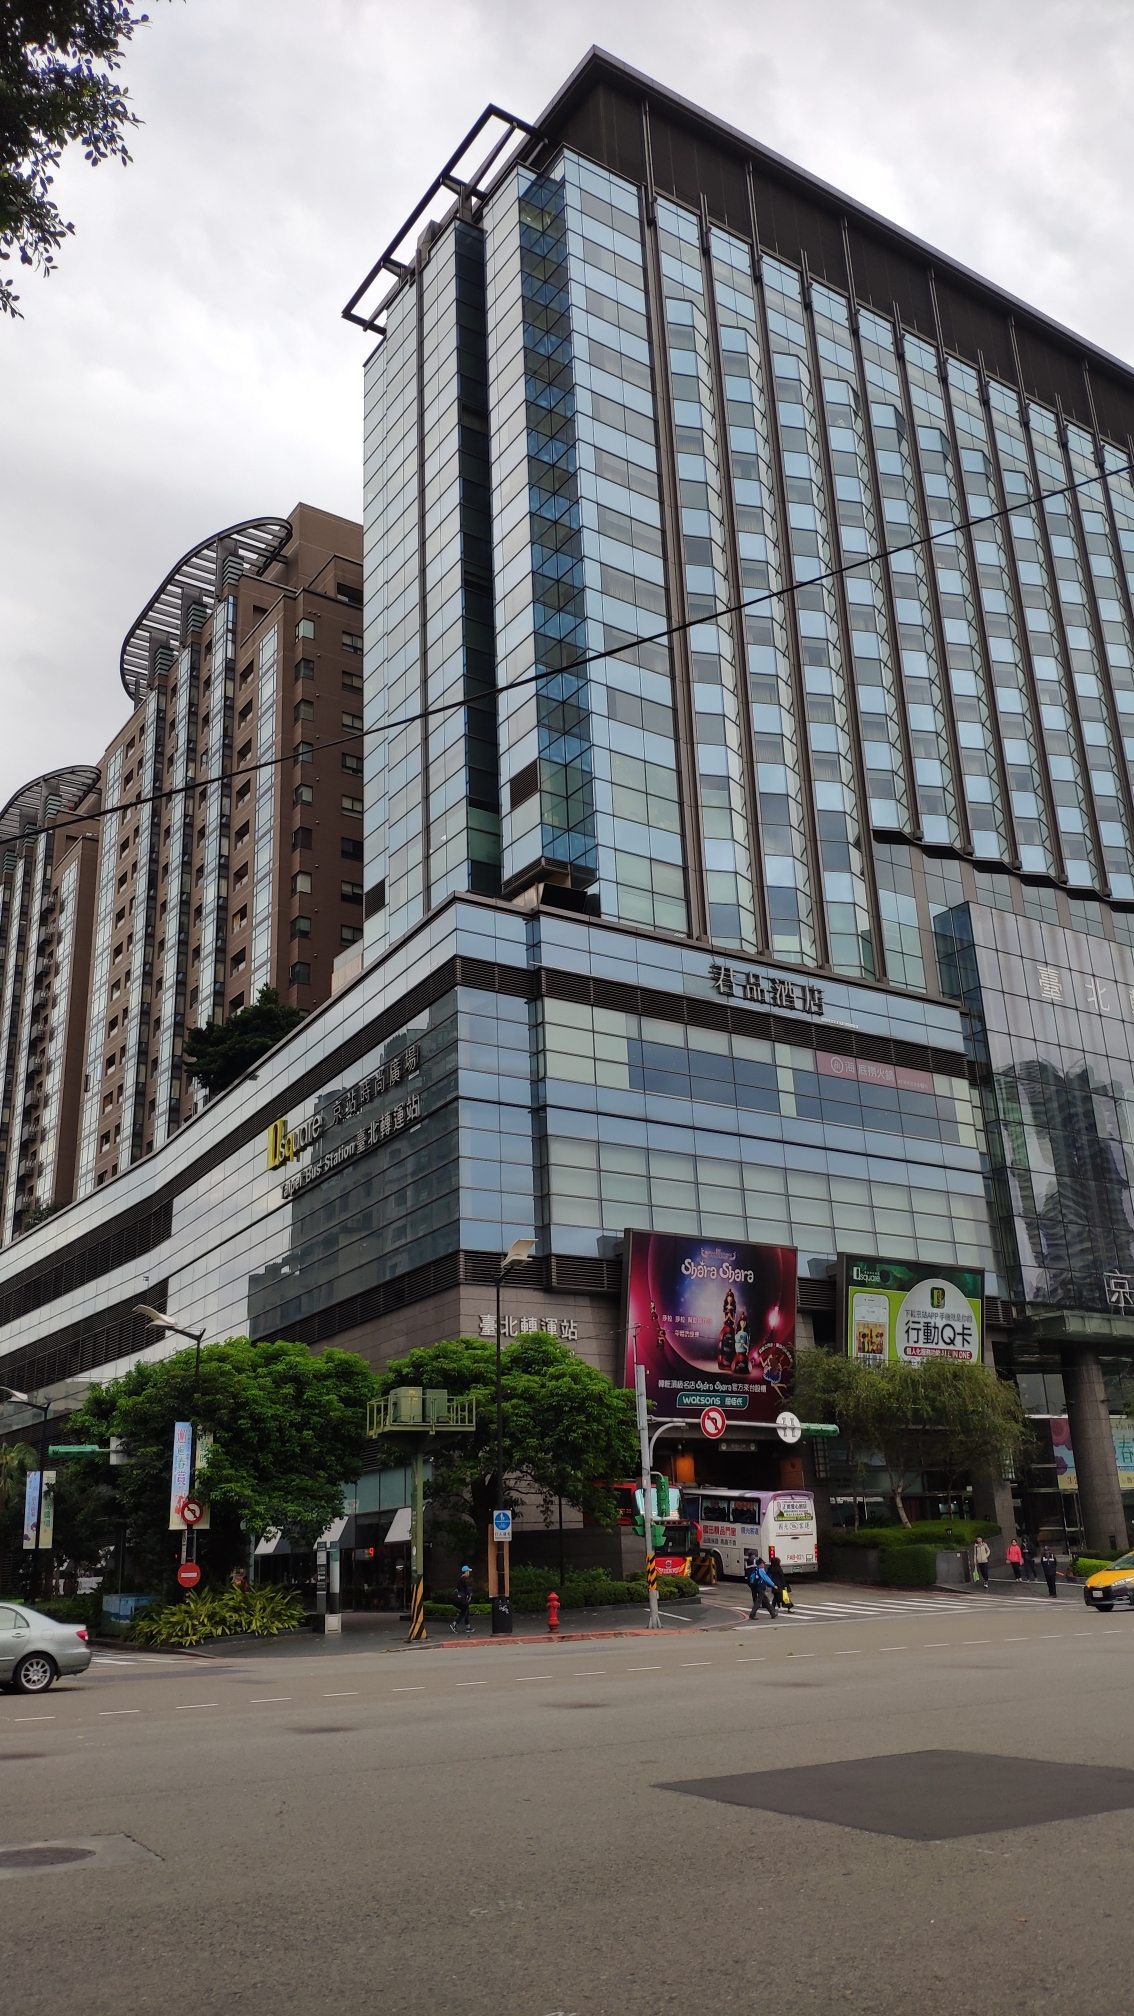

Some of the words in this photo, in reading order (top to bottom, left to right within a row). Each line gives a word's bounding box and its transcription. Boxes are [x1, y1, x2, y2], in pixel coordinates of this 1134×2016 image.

[711, 966, 824, 1016] 君品酒店
[1037, 966, 1134, 1015] 臺北
[332, 1045, 420, 1125] 京站時尚廣場
[845, 1062, 894, 1081] 海底撈火鍋
[356, 1094, 420, 1154] 臺北轉運站
[281, 1175, 303, 1199] Taipei
[305, 1164, 321, 1184] Bus
[324, 1141, 356, 1172] Station
[681, 1258, 717, 1280] Shara
[719, 1262, 754, 1283] Shara
[480, 1313, 578, 1340] 臺北轉運站
[905, 1320, 972, 1347] 行動Q卡
[959, 1351, 970, 1359] ONE
[682, 1395, 721, 1405] watsons
